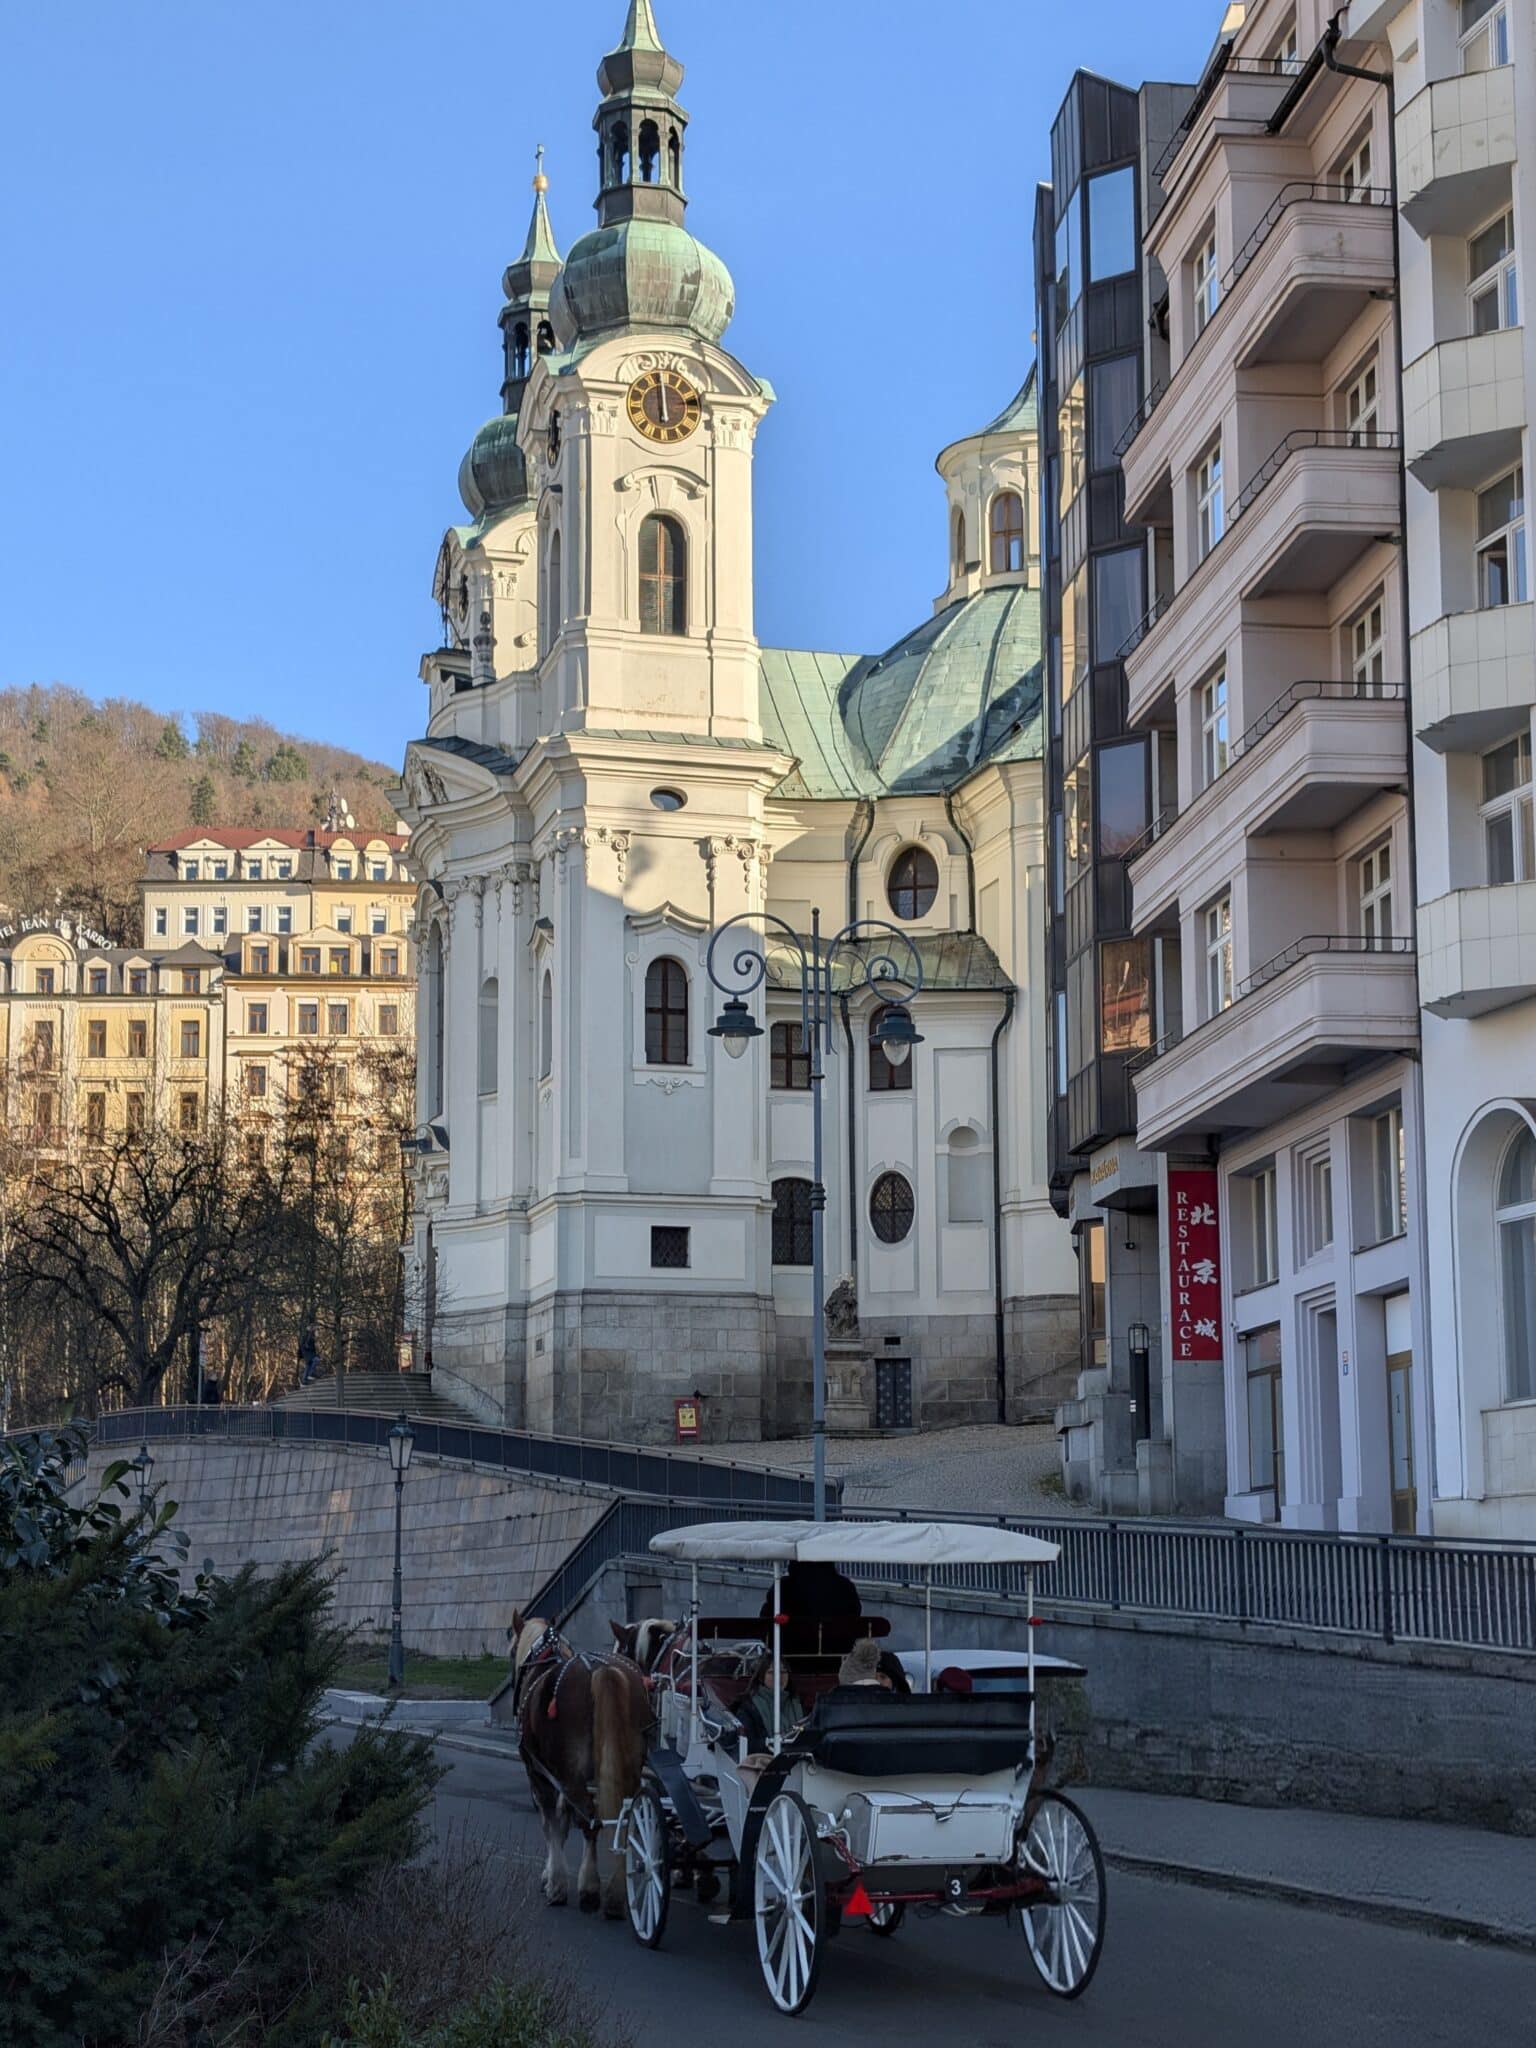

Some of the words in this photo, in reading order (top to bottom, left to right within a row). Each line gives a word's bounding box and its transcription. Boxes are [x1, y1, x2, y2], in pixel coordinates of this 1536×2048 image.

[21, 918, 48, 933] JEAN
[1176, 1191, 1192, 1357] RESTAURACE
[951, 1879, 961, 1896] 3
